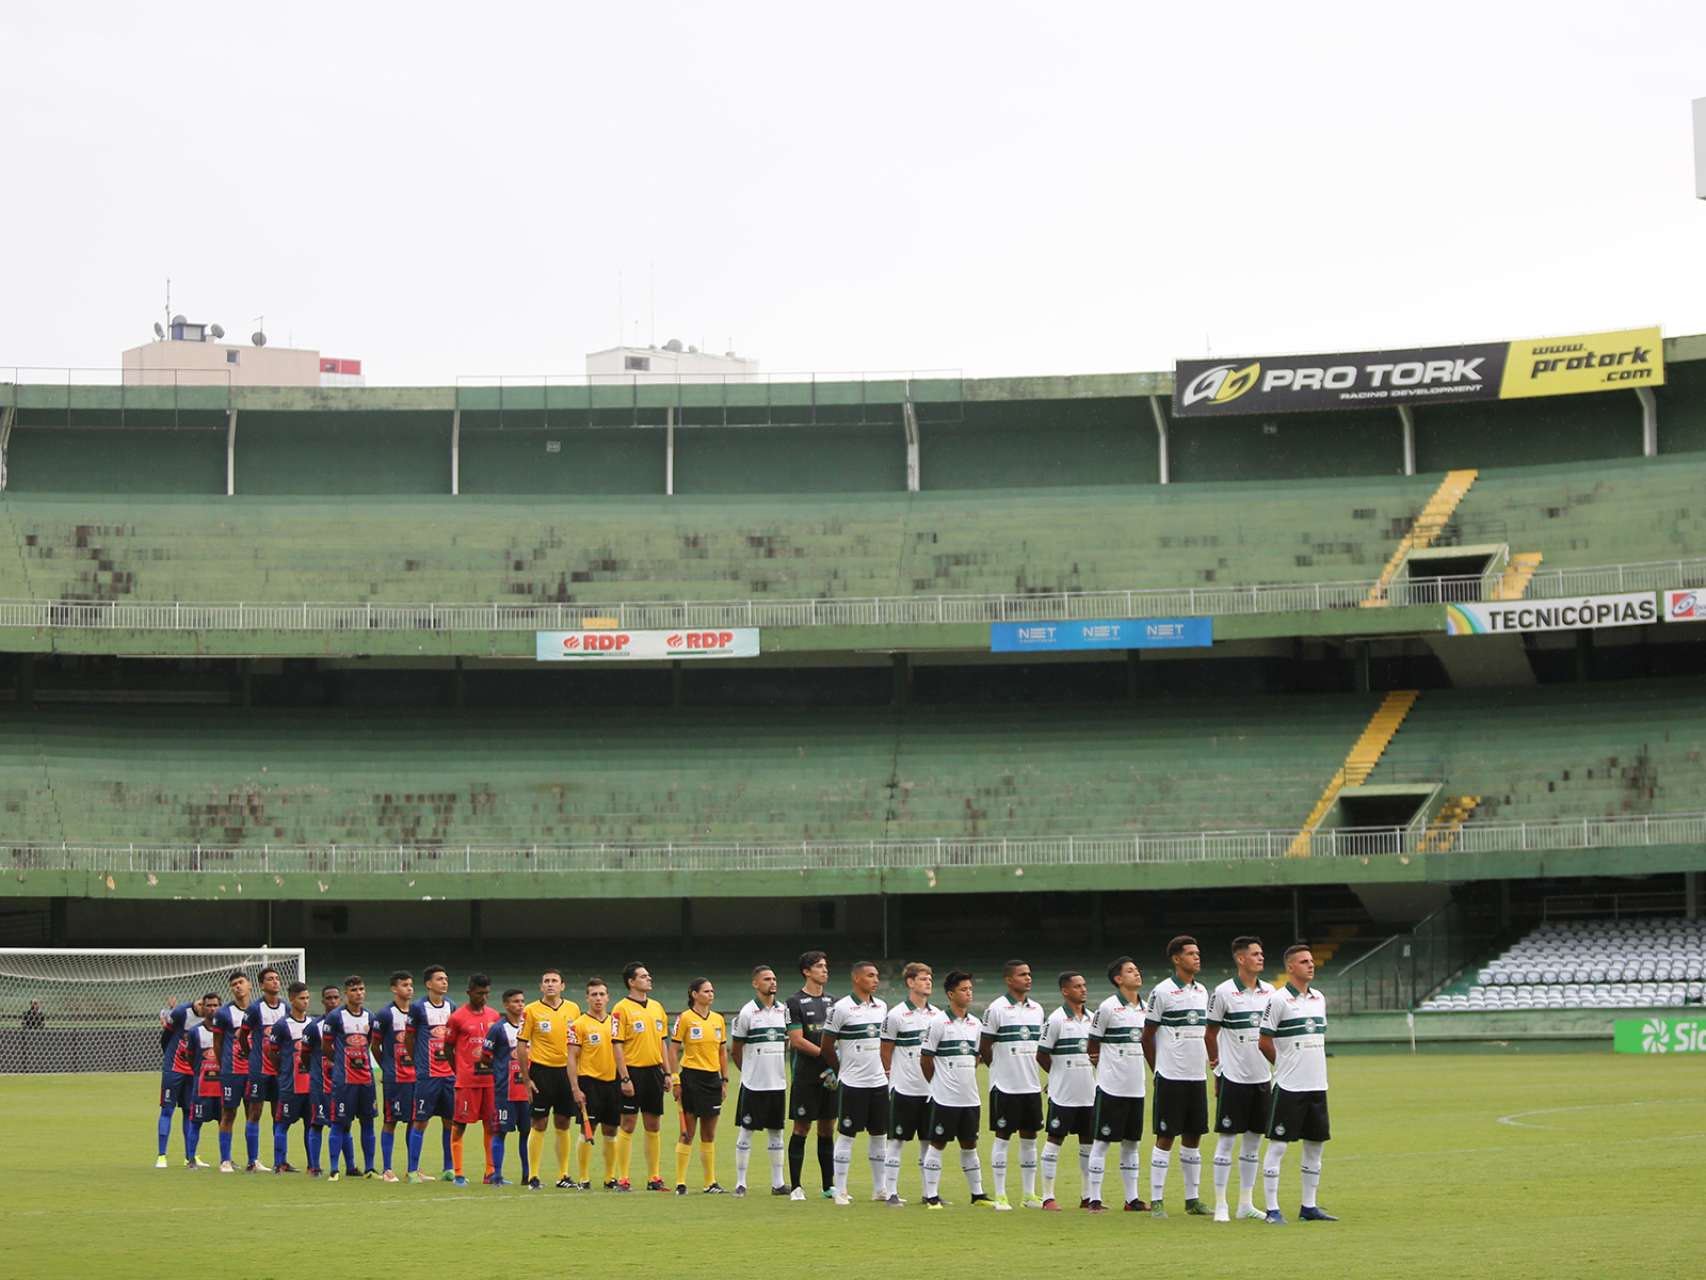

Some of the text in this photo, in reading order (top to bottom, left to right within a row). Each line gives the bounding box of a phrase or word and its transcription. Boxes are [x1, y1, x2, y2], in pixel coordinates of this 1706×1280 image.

[1530, 346, 1652, 380] protork
[1261, 357, 1486, 393] PRO TORK
[1601, 368, 1652, 383] .com
[1340, 384, 1483, 401] RACING DEVELOPMENT
[1489, 599, 1655, 630] TECNICÓPIAS
[1018, 628, 1056, 639] NET
[1083, 626, 1120, 637] NET
[1147, 624, 1184, 635] NET
[583, 634, 630, 651] RDP
[687, 632, 734, 649] RDP
[252, 1083, 258, 1093] 3
[419, 1099, 425, 1110] 7
[499, 1109, 508, 1120] 10
